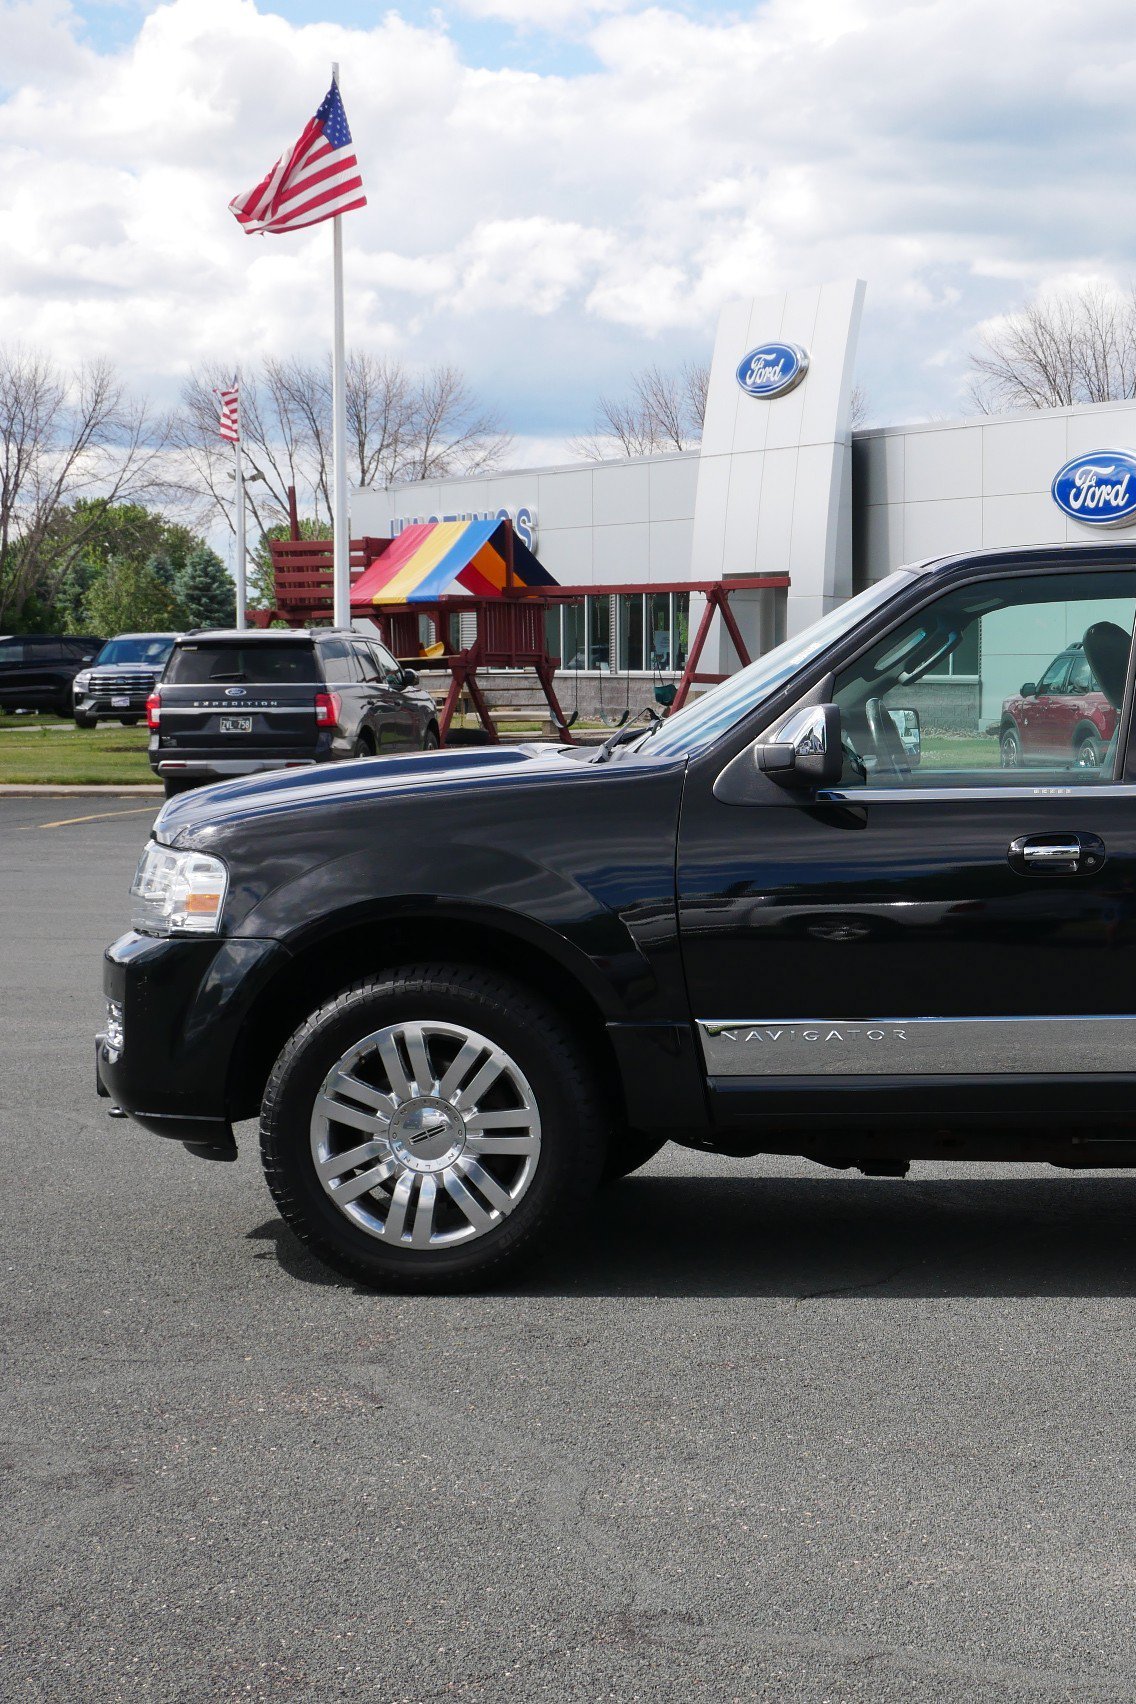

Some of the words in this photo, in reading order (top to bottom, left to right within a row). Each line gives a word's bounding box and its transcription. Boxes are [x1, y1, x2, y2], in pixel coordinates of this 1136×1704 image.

[746, 353, 785, 386] Ford
[1069, 465, 1130, 509] Ford
[720, 1029, 907, 1042] NAVIGATOR
